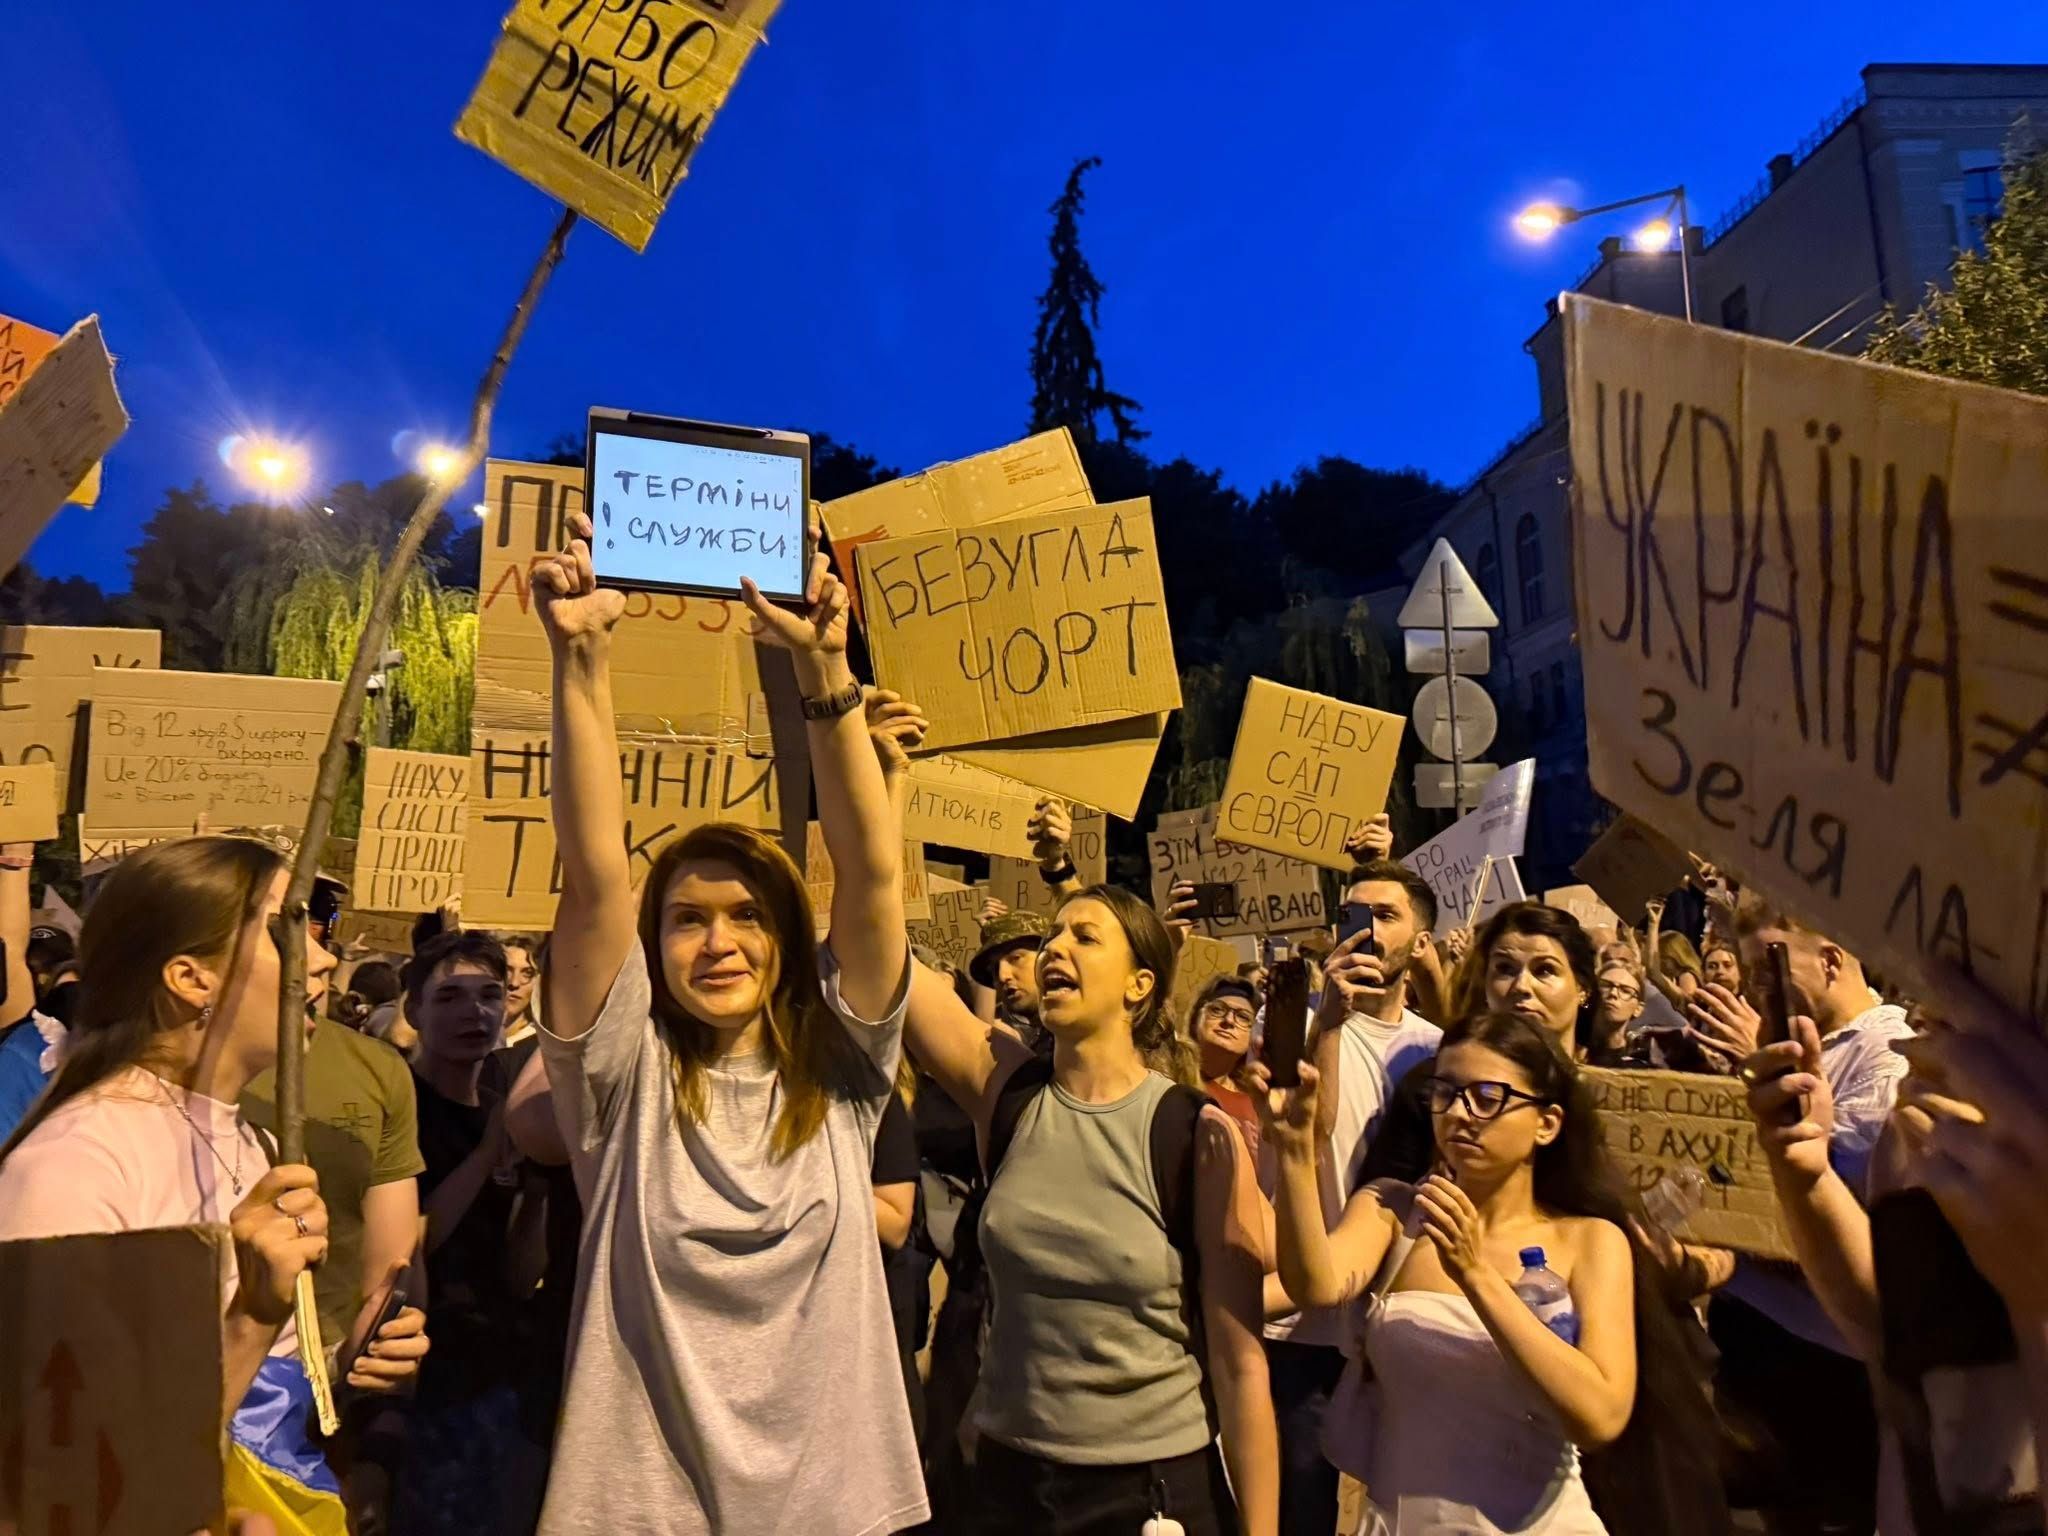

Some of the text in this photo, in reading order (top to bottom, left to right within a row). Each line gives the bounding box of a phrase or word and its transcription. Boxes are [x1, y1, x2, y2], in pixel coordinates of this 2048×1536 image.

[513, 39, 703, 199] РЕЖИМ
[628, 516, 787, 559] СЛУЖБИ
[1596, 380, 1963, 820] УКРАЇНА
[959, 596, 1157, 702] ЧОРТ
[1279, 695, 1385, 753] НАБУ
[387, 761, 468, 803] НАХУ
[1266, 750, 1341, 798] САП
